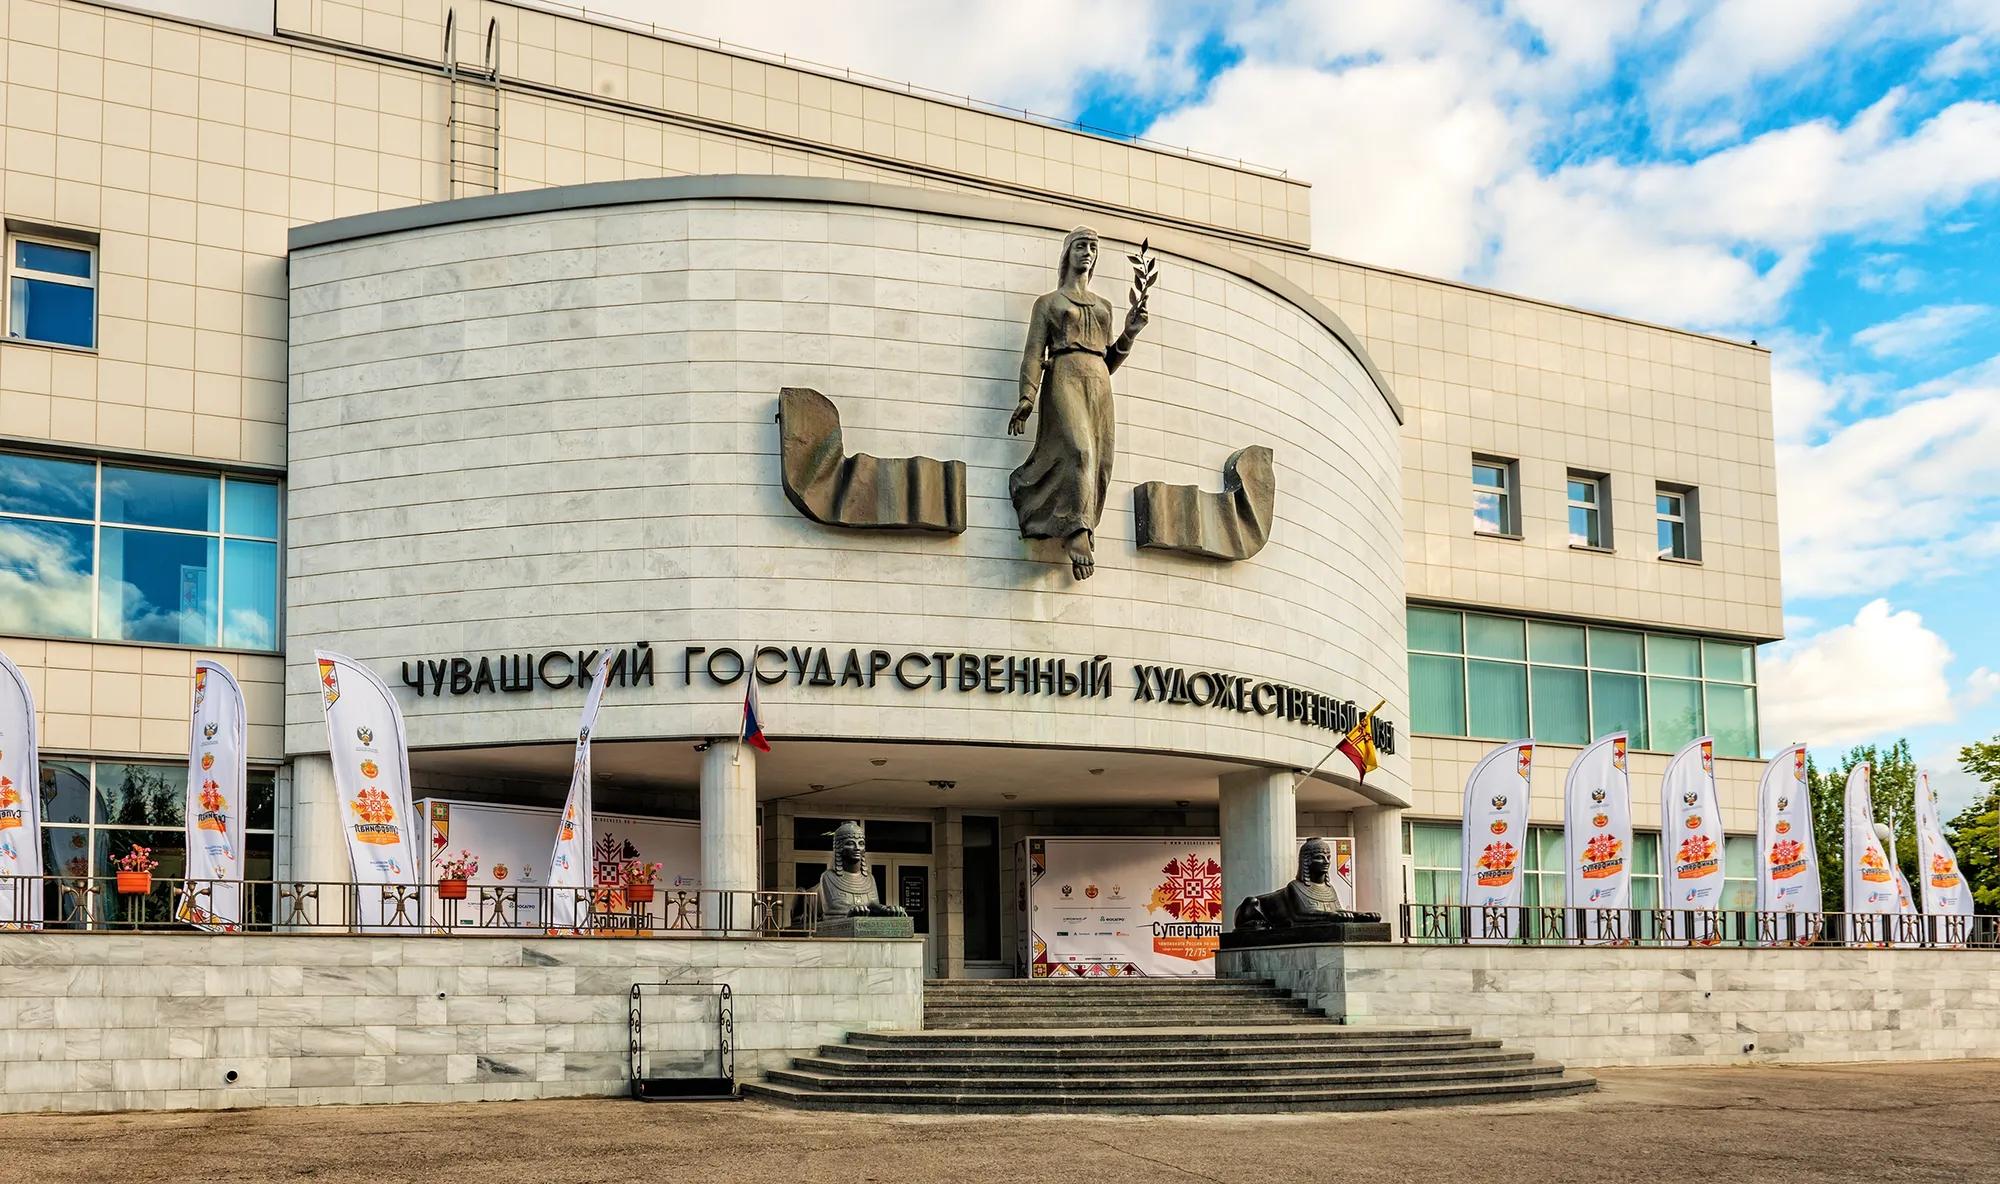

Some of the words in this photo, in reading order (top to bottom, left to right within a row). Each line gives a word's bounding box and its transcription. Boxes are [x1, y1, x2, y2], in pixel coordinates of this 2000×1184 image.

[402, 641, 654, 697] ЧУВАШСКИЙ
[684, 645, 1112, 699] ГОСУДАРСТВЕННЫЙ
[1131, 664, 1357, 735] ХУДОЖЕСТВЕННЫЙ
[1152, 921, 1221, 940] Суперфин
